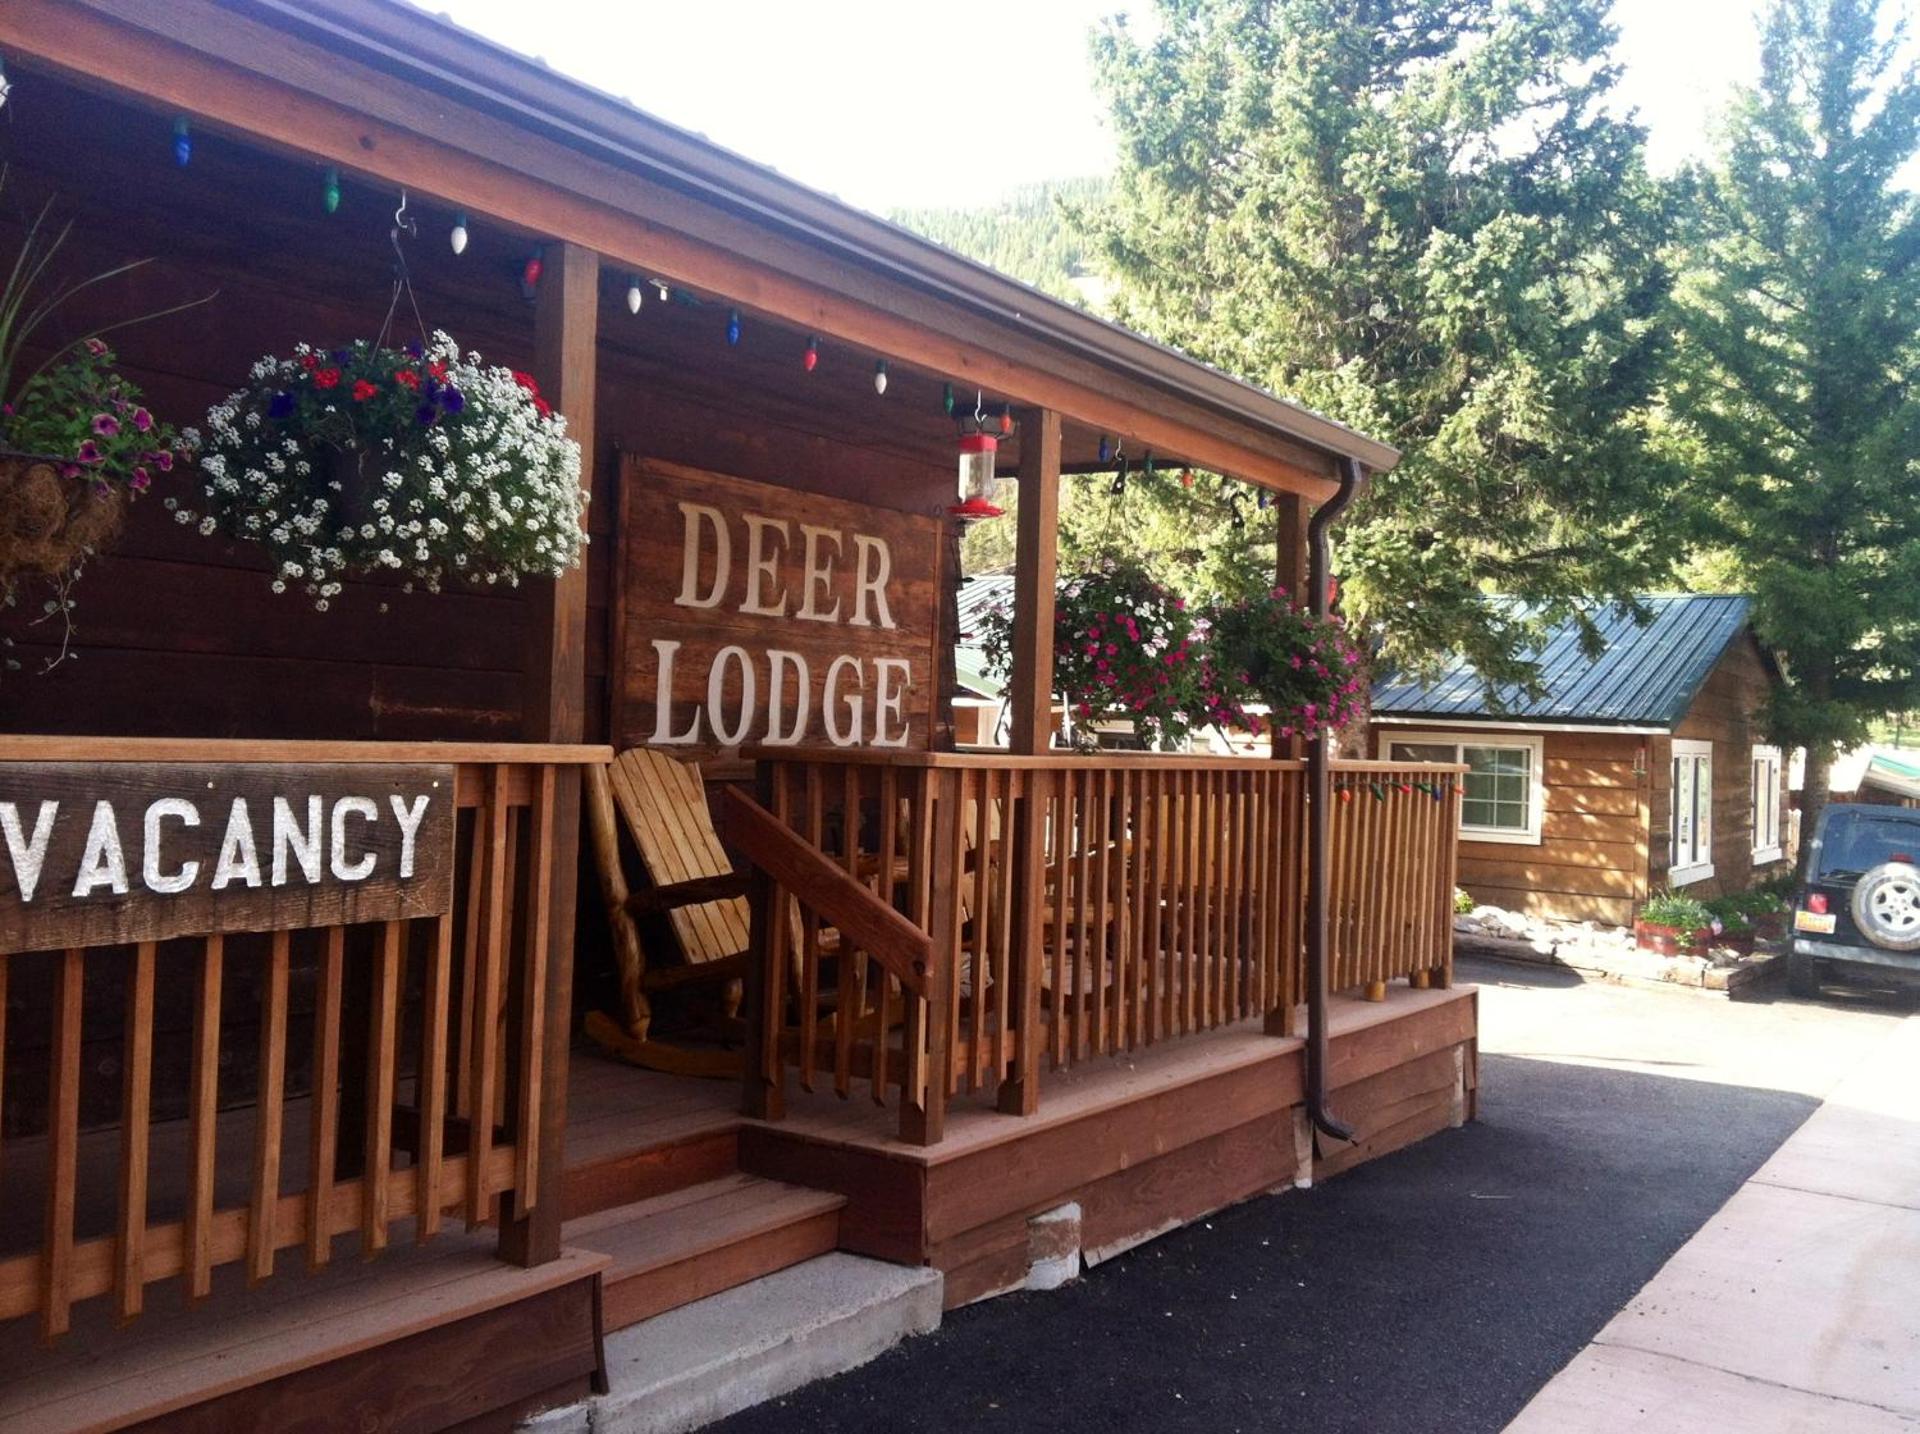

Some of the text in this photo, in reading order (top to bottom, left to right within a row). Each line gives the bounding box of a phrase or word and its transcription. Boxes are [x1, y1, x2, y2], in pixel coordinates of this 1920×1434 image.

[674, 502, 896, 629] DEER
[648, 639, 911, 748] LODGE
[0, 795, 430, 902] VACANCY
